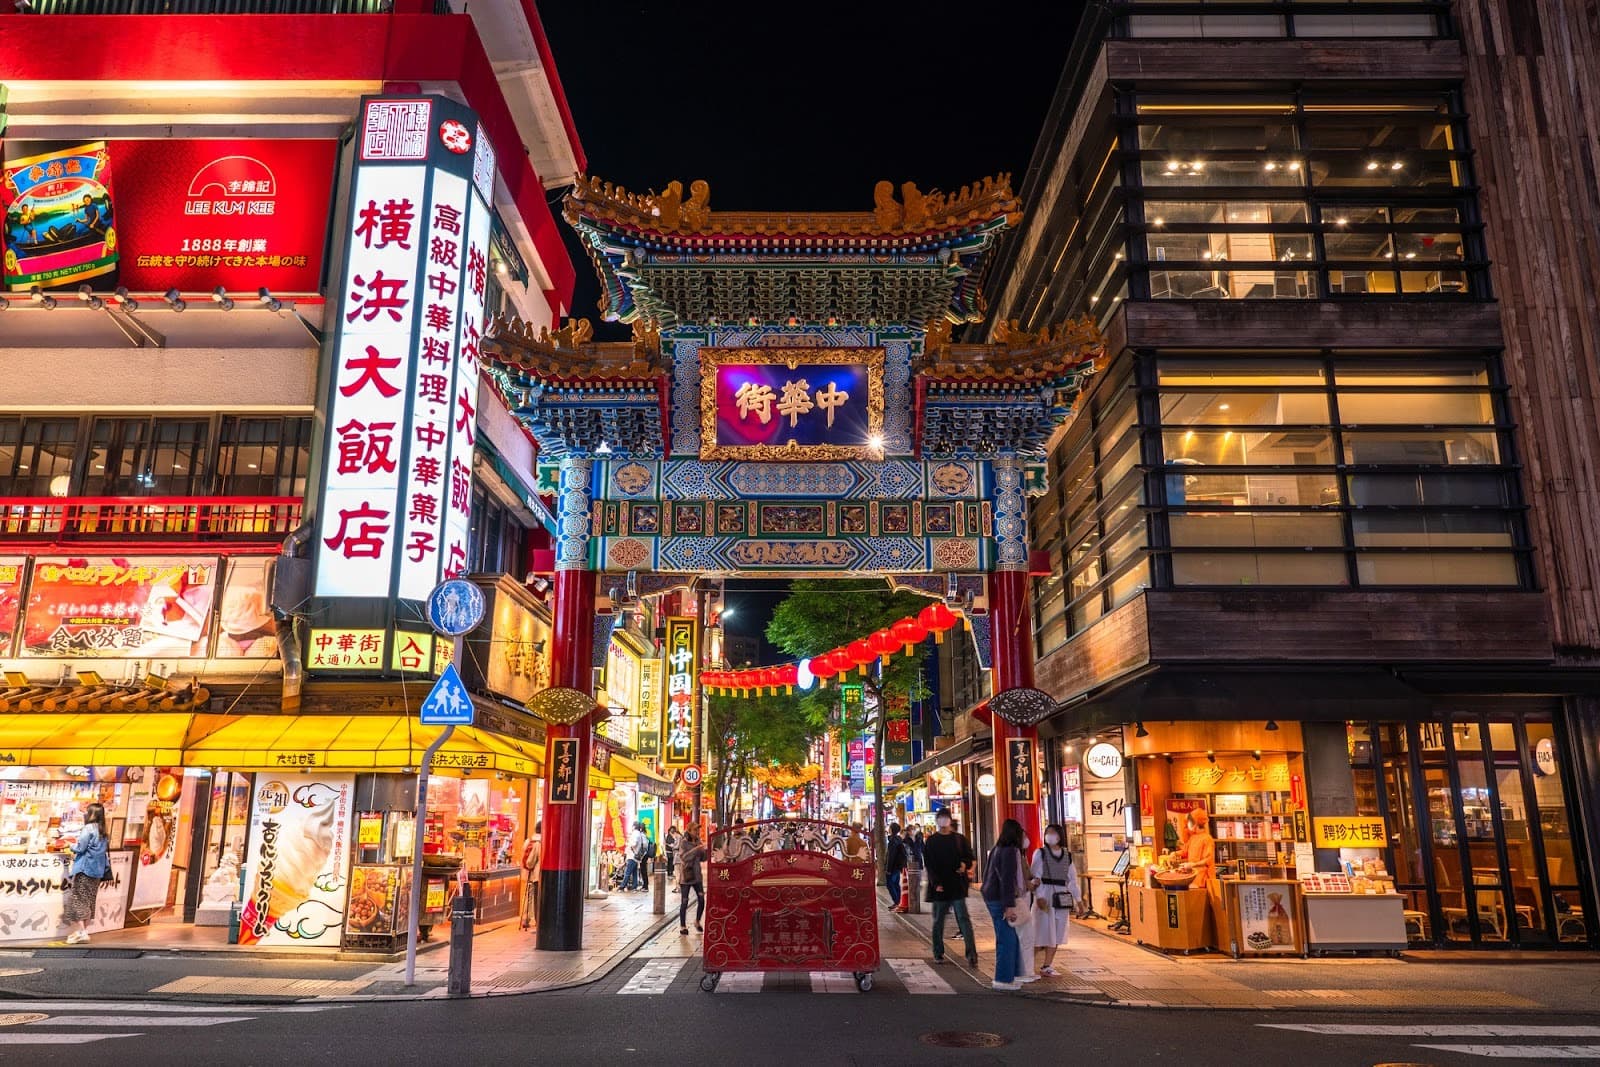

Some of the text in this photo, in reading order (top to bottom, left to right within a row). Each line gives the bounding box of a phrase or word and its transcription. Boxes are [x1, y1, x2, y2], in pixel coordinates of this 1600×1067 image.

[228, 180, 271, 193] 李錦記
[184, 201, 275, 215] LEE KUM KEE
[181, 239, 267, 253] 1888年創業
[136, 255, 307, 267] 伝統を守り続けてきた本場の味
[323, 198, 415, 559] 横浜大飯店
[405, 203, 462, 564] 高級中華料理・中華菓子
[50, 627, 144, 648] 食べ放題
[315, 633, 382, 652] 中華街
[314, 654, 379, 665] 大通り入口
[400, 636, 425, 668] 入口
[641, 663, 651, 727] 世界一の肉まん
[1101, 755, 1119, 767] CAFE
[686, 770, 698, 781] 30
[258, 784, 289, 807] 元祖
[1322, 823, 1384, 841] 聘珍大甘栗
[254, 818, 281, 936] 杏仁ソフトクリーム
